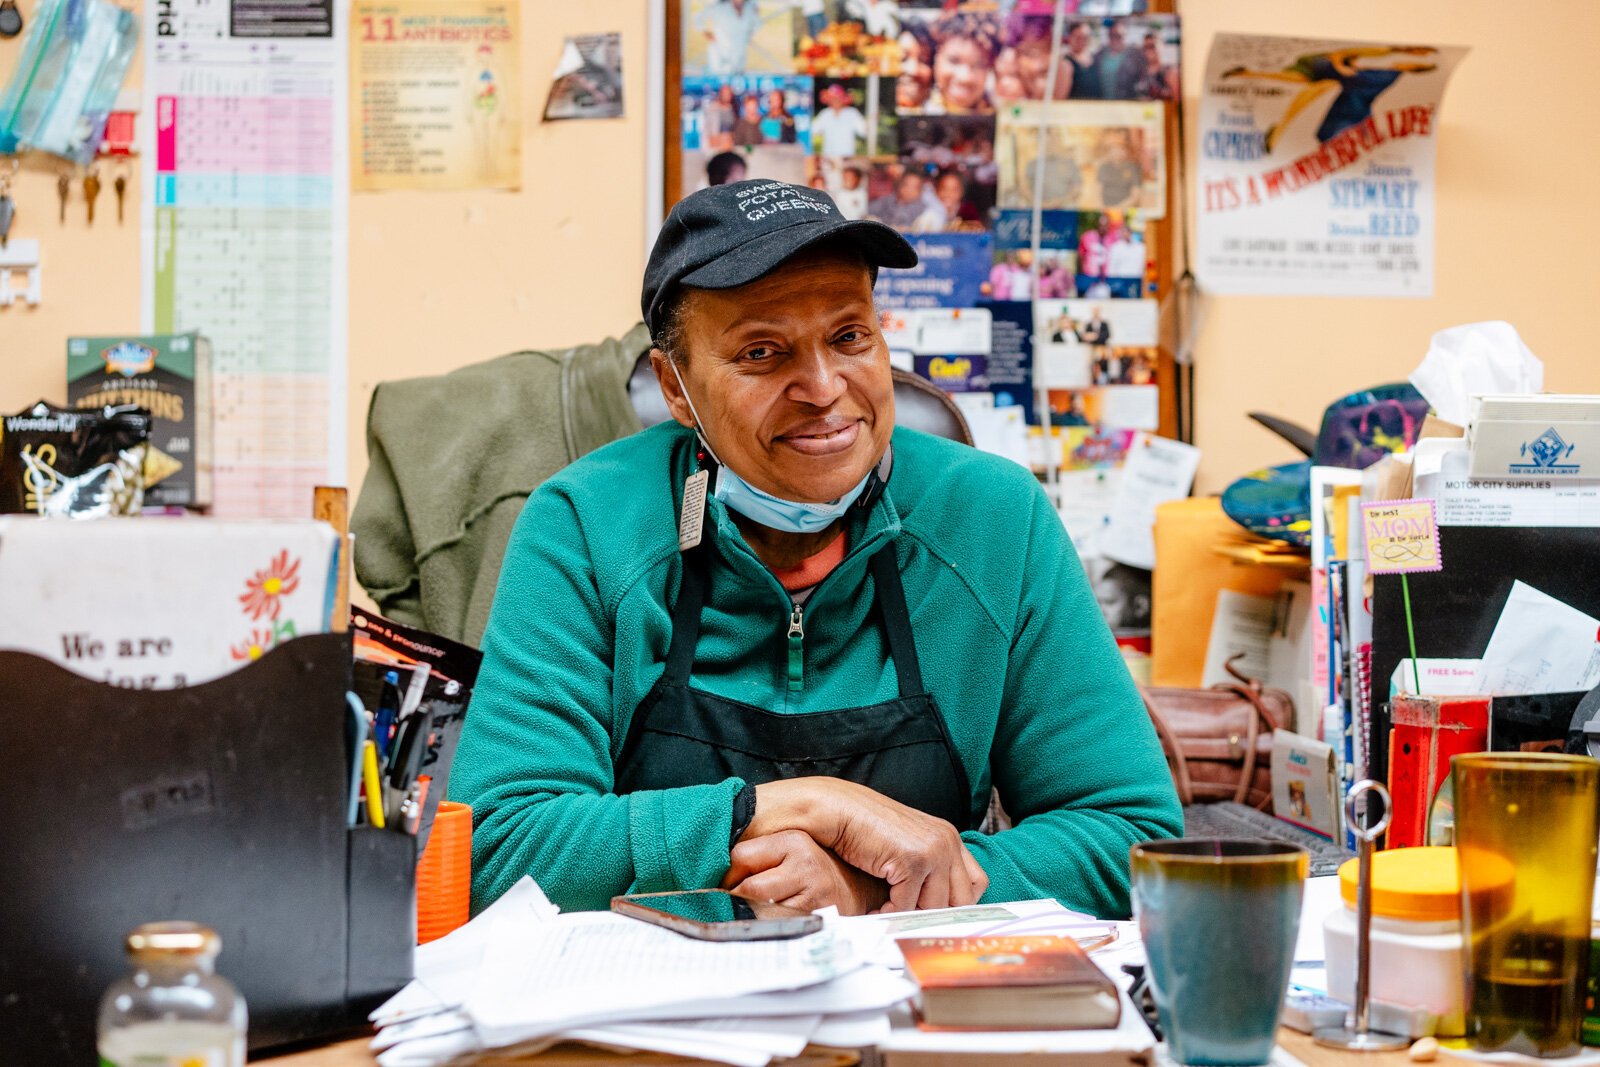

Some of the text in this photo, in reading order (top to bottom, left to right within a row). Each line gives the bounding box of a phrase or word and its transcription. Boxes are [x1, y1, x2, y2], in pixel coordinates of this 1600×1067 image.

[361, 16, 397, 42] 11
[403, 26, 513, 42] ANTIBIOTICS
[1204, 103, 1436, 213] IT'S A WONDERFUL LIFE
[7, 412, 77, 433] Wonderful
[1445, 481, 1552, 489] MOTOR CITY SUPPLIES
[1369, 517, 1430, 538] MOM
[384, 628, 393, 638] &
[61, 633, 173, 660] We are
